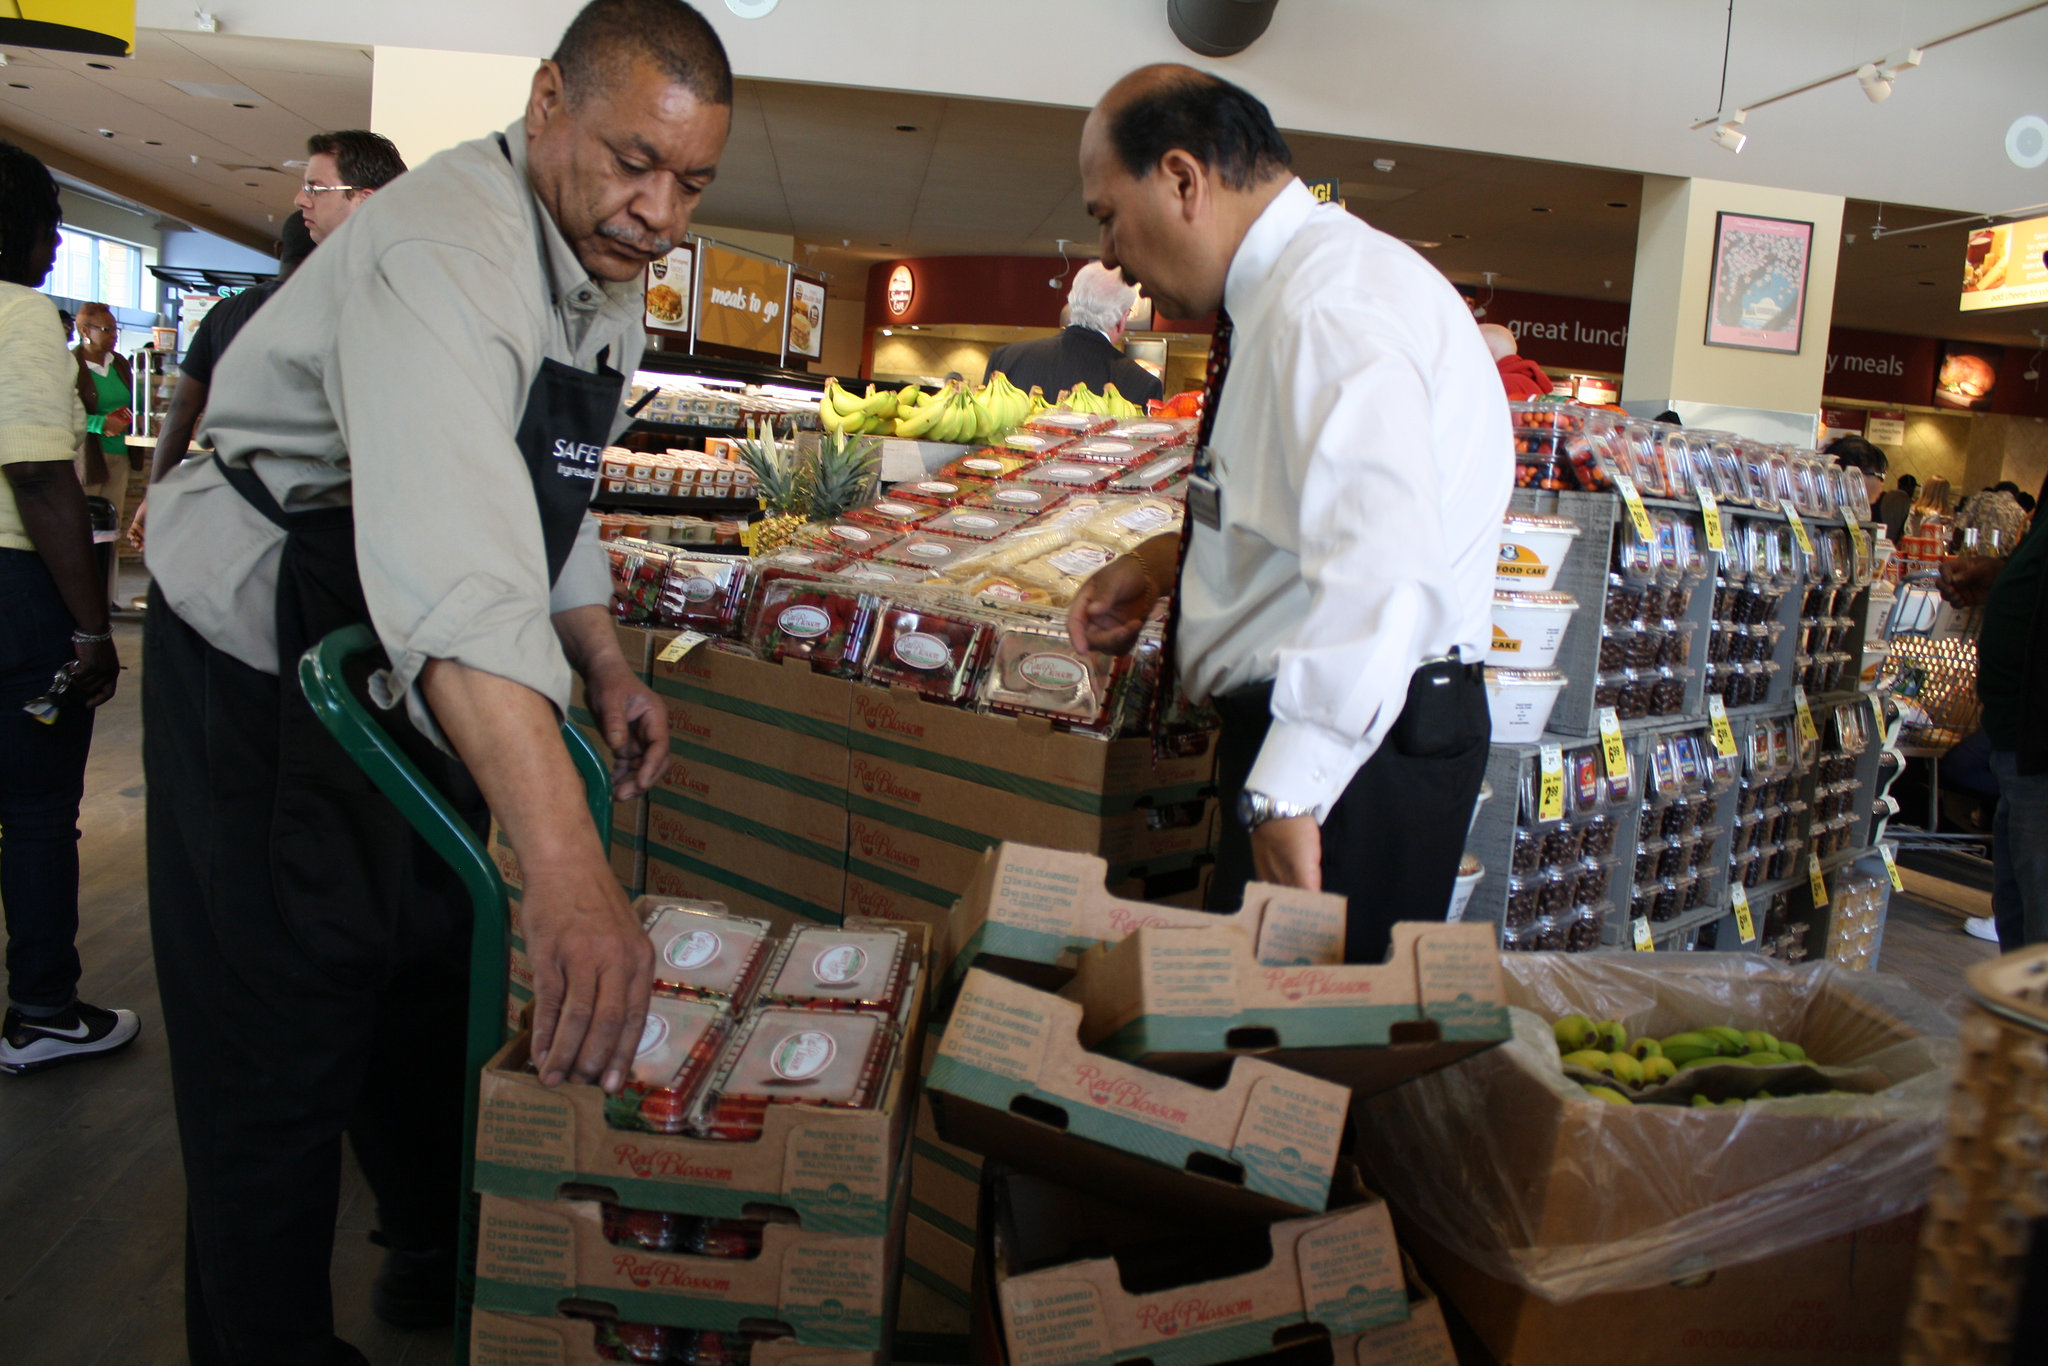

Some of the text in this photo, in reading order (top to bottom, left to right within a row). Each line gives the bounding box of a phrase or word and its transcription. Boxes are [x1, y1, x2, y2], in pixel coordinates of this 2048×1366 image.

[711, 286, 779, 323] meals to go
[1507, 316, 1568, 341] great
[1843, 355, 1904, 376] meals
[552, 438, 601, 464] SAFE
[1496, 565, 1546, 576] FOOD CAKE
[1492, 640, 1519, 650] CAKE
[877, 702, 925, 738] Blossom
[875, 767, 922, 803] Blossom
[875, 833, 921, 868] Blossom
[1263, 967, 1304, 997] Red
[1303, 967, 1373, 997] Blossom
[1075, 1063, 1125, 1101] Red
[1114, 1081, 1189, 1124] Blossom
[613, 1143, 733, 1182] Red Blossom
[612, 1253, 731, 1291] Red Blossom
[1135, 1298, 1254, 1334] Red Blossom
